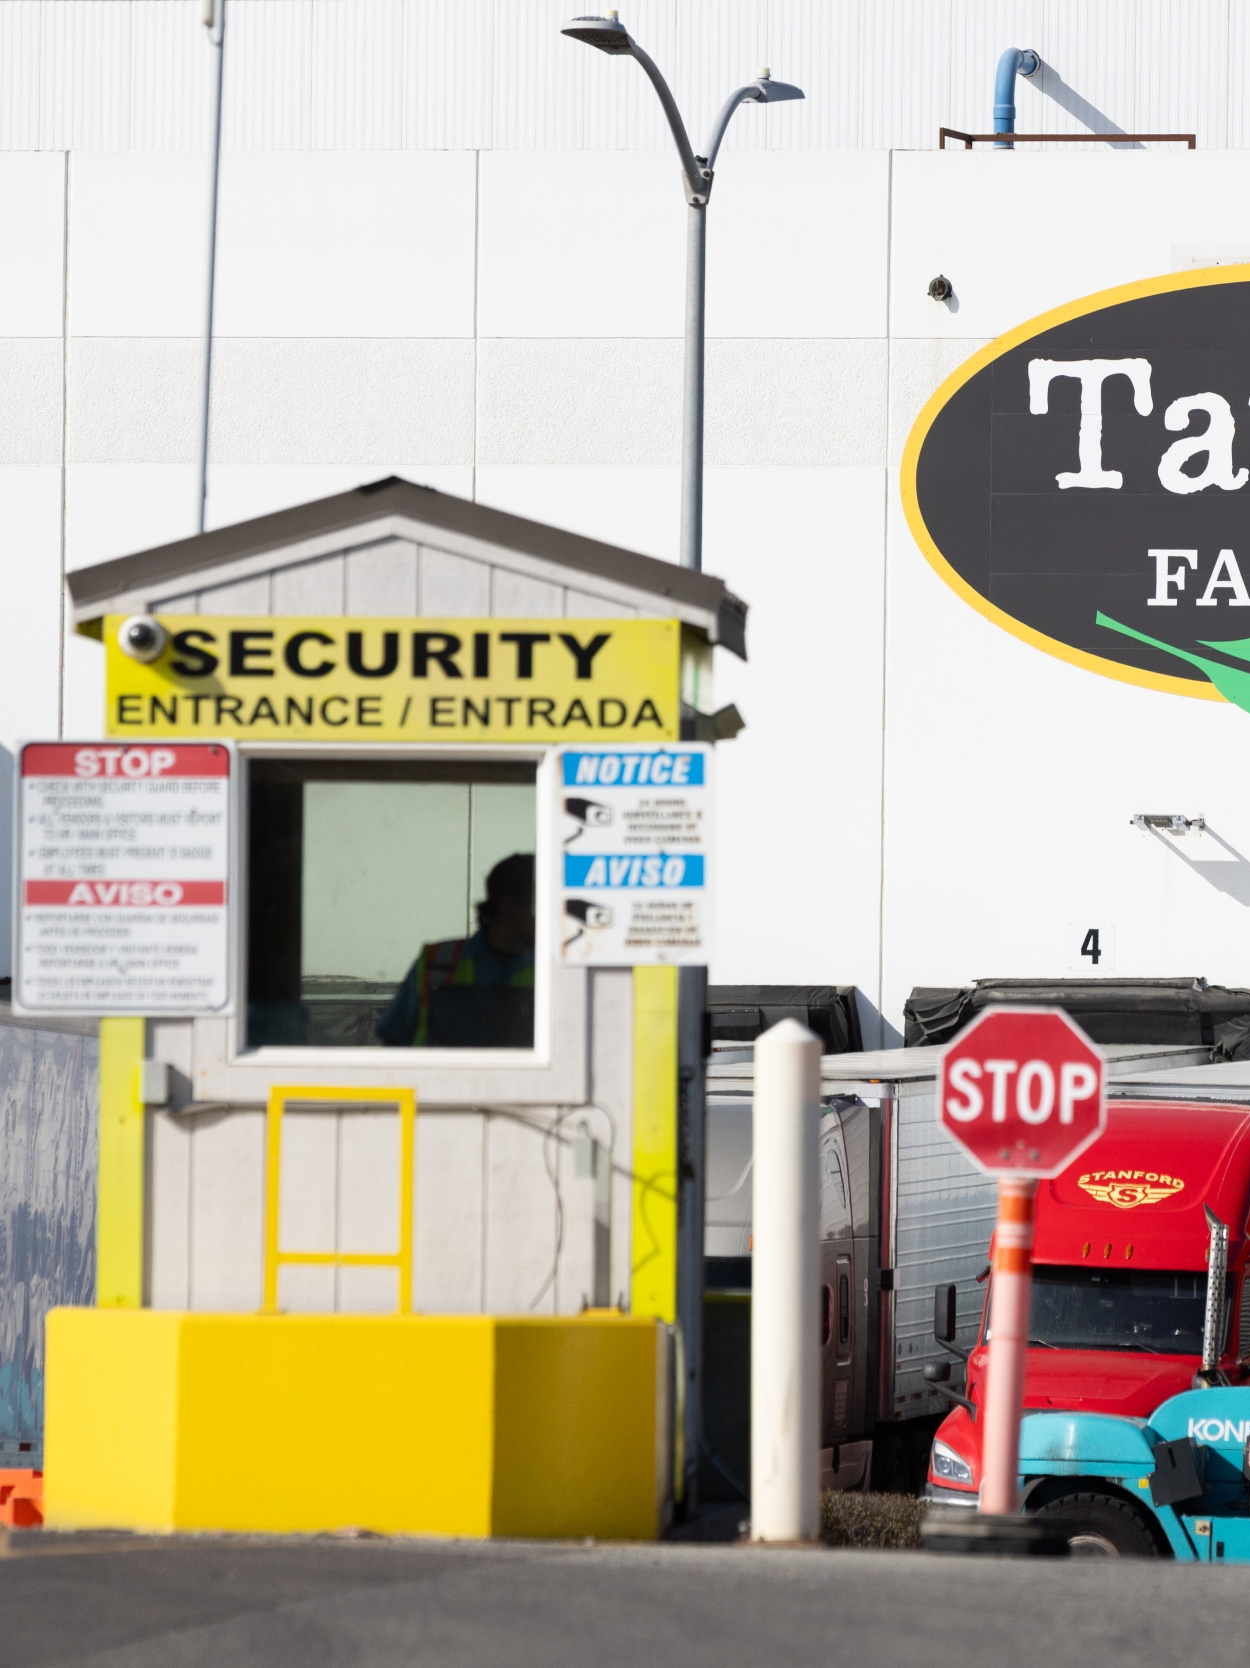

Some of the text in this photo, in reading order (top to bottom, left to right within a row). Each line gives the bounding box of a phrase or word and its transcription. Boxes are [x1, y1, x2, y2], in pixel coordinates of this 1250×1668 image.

[171, 629, 611, 680] SECURITY
[117, 696, 382, 726] ENTRANCE
[429, 697, 664, 728] ENTRADA
[75, 748, 176, 777] STOP
[576, 755, 691, 784] NOTICE
[584, 856, 686, 886] AVISO
[68, 883, 184, 905] AVISO
[1080, 928, 1102, 965] 4
[945, 1058, 1098, 1125] STOP
[1077, 1170, 1185, 1190] STANFORD
